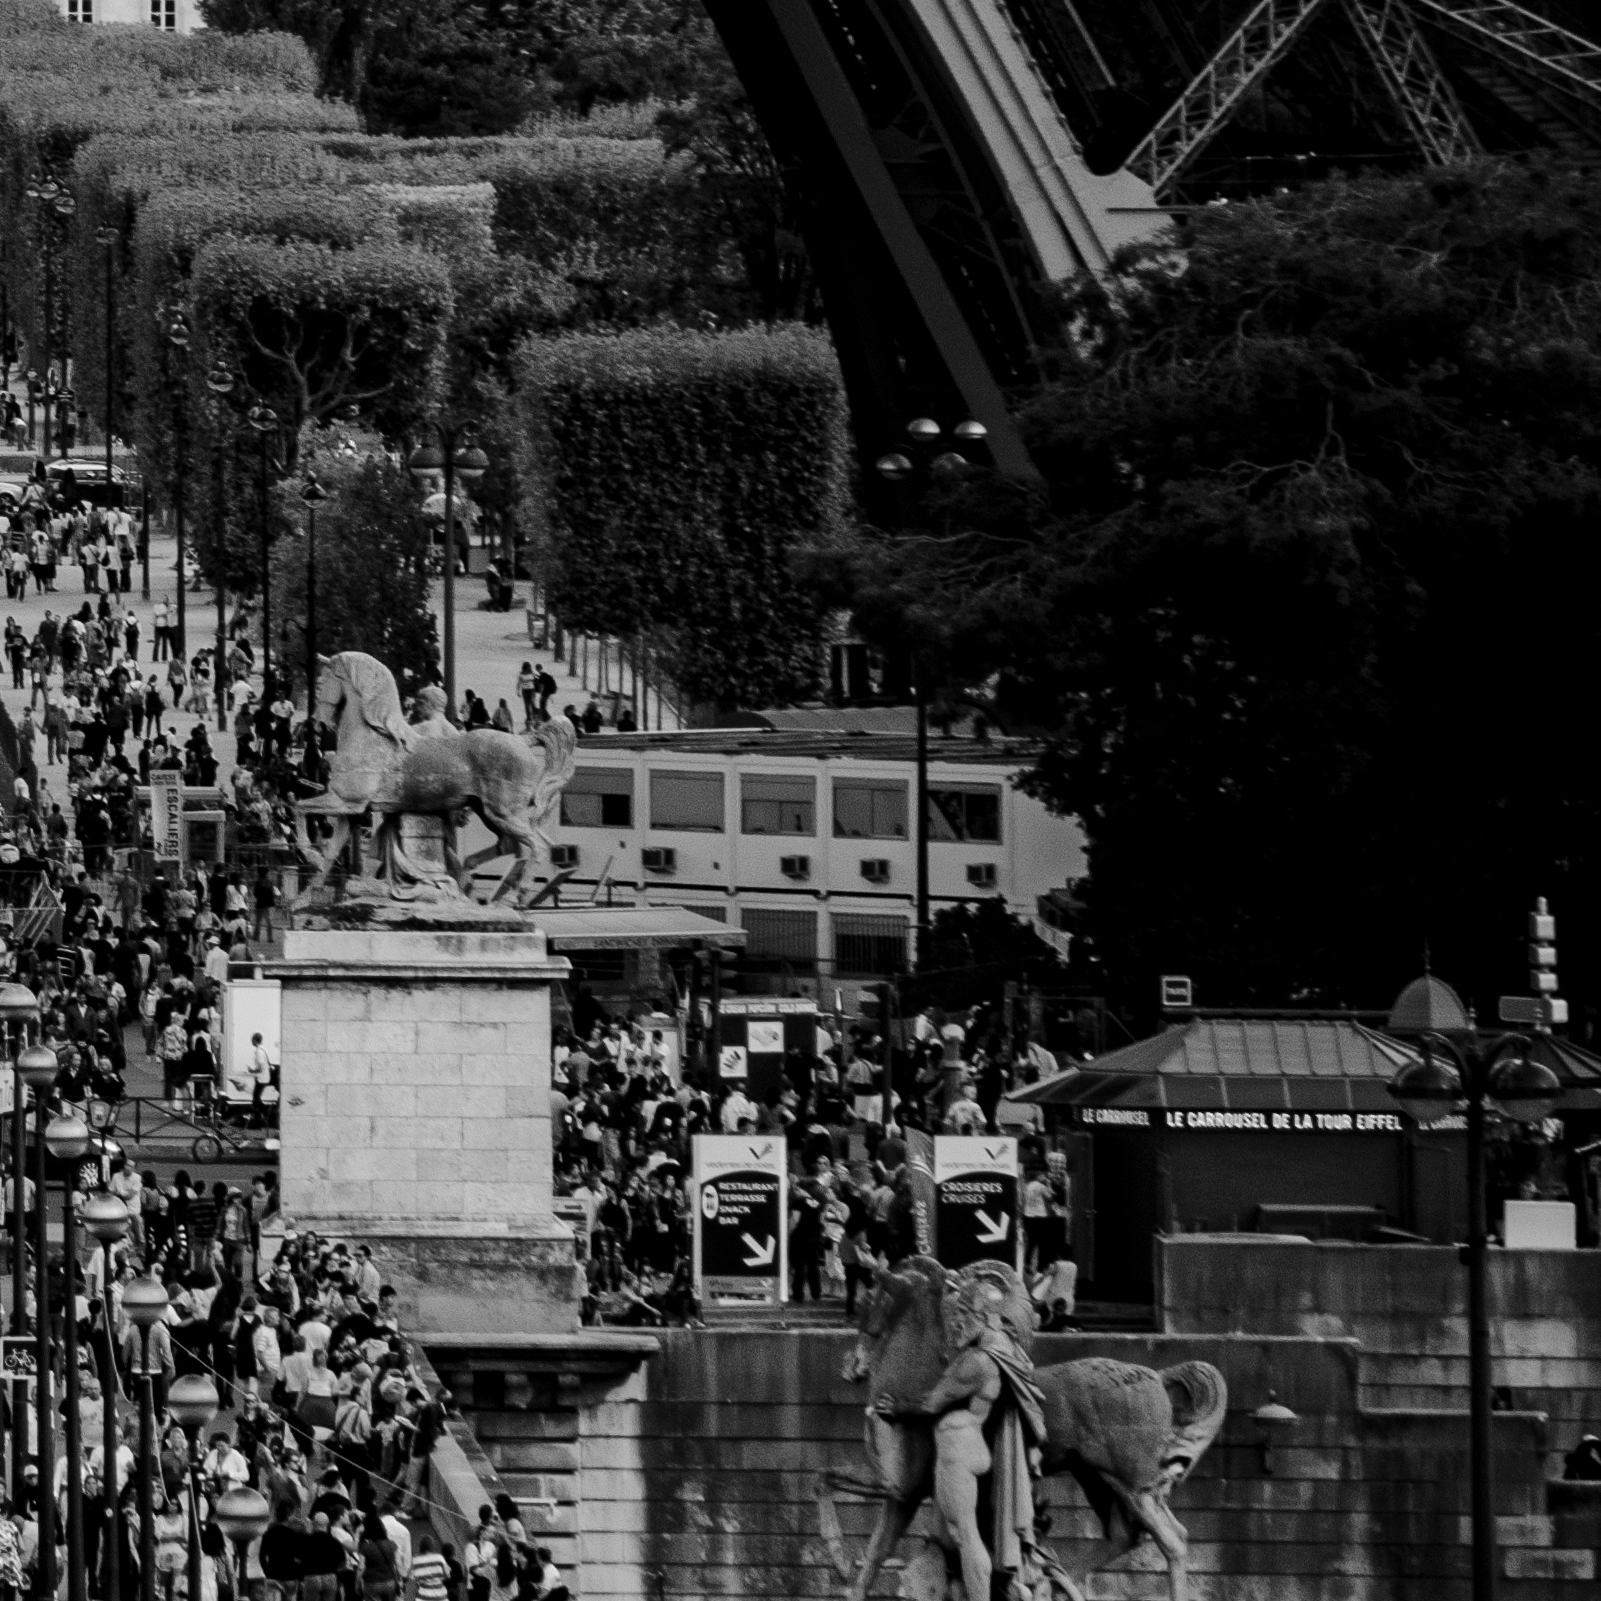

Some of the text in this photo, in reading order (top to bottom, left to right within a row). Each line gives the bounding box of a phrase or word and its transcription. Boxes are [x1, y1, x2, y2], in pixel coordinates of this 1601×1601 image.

[167, 788, 179, 857] ESCALIERS
[1096, 1108, 1150, 1126] CARROUSEL
[1166, 1111, 1184, 1127] LE
[1187, 1111, 1268, 1129] CARROUSEL
[1272, 1112, 1291, 1129] DE
[1294, 1113, 1313, 1129] LA
[1316, 1113, 1352, 1130] TOUR
[1356, 1114, 1403, 1131] EIFFEL
[718, 1181, 779, 1191] RESTAURANT
[718, 1193, 767, 1203] TERRASSE
[941, 1193, 986, 1204] CRUISES
[718, 1204, 751, 1214] SNACK
[718, 1216, 740, 1225] BAR
